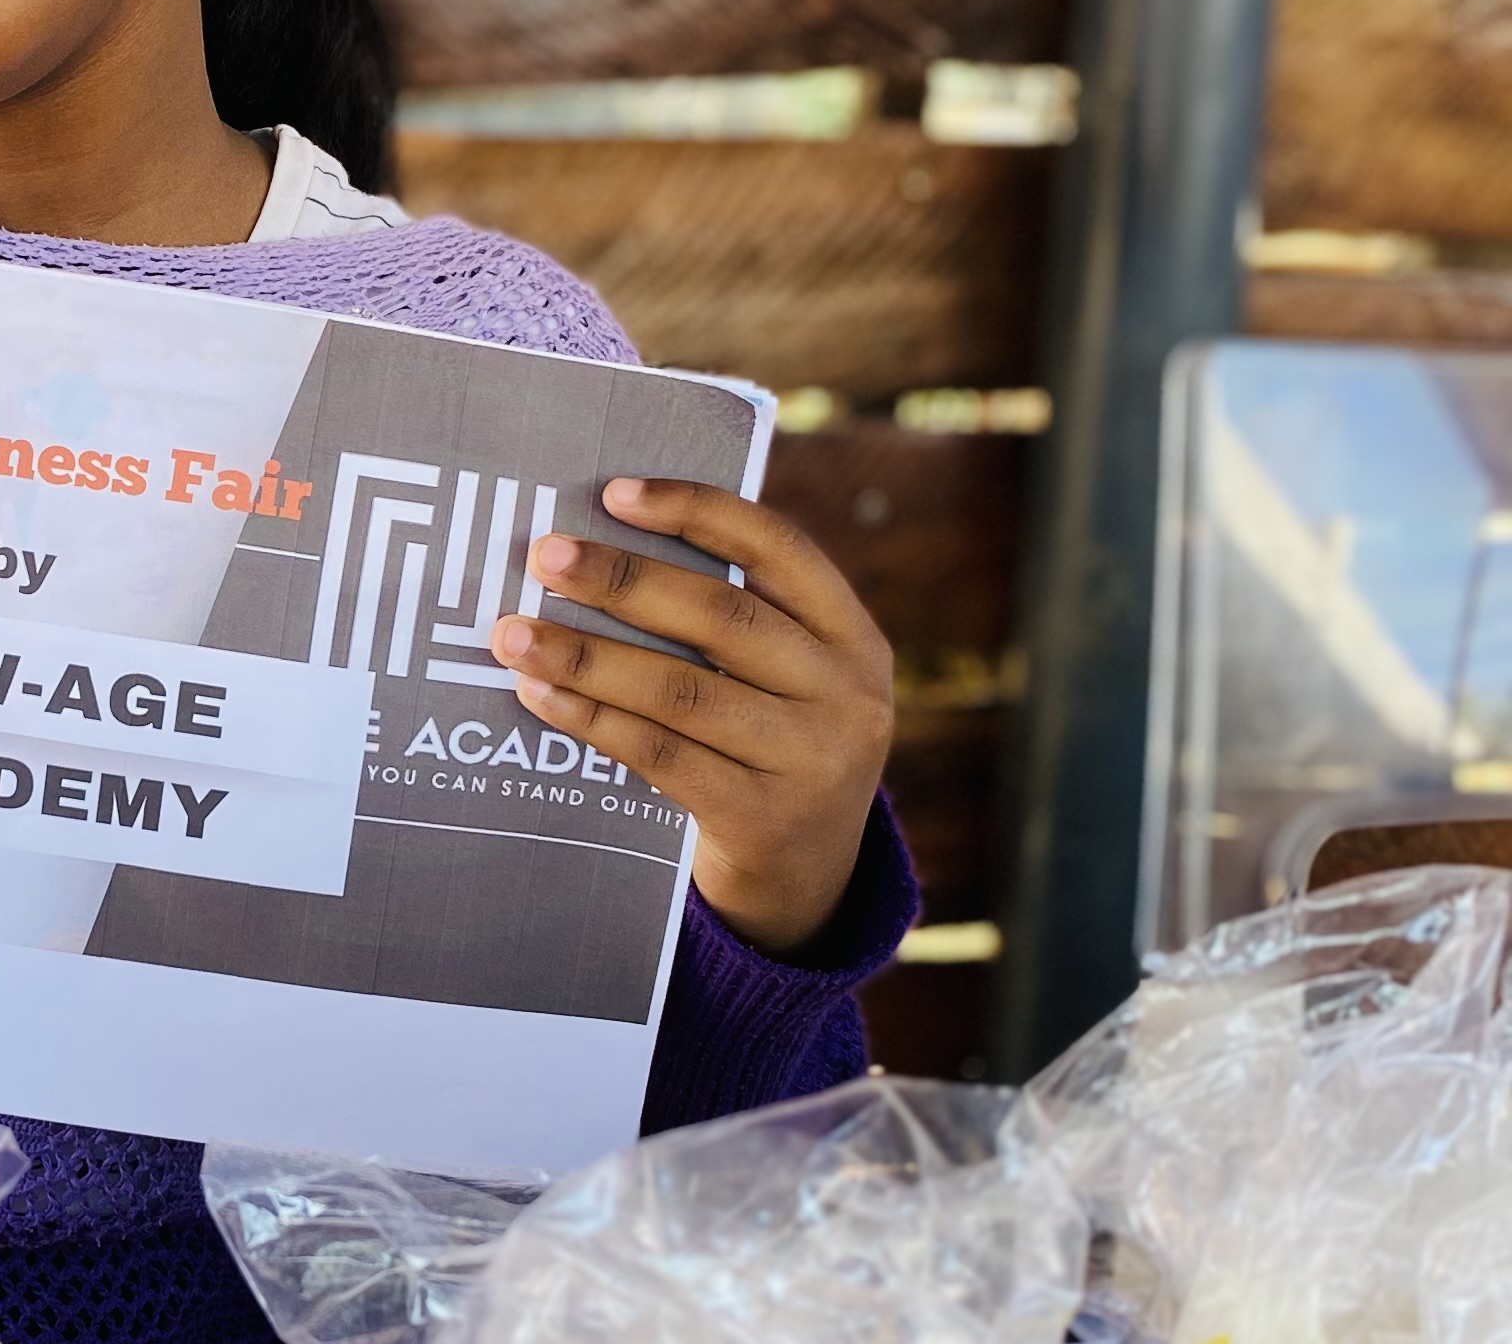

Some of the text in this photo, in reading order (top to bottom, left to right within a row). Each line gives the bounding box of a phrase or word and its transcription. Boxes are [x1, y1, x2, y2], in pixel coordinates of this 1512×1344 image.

[165, 449, 313, 521] Fair
[368, 764, 418, 786] YOU
[431, 772, 487, 794] CAN
[500, 780, 585, 807] STAND
[404, 716, 662, 795] ACADE
